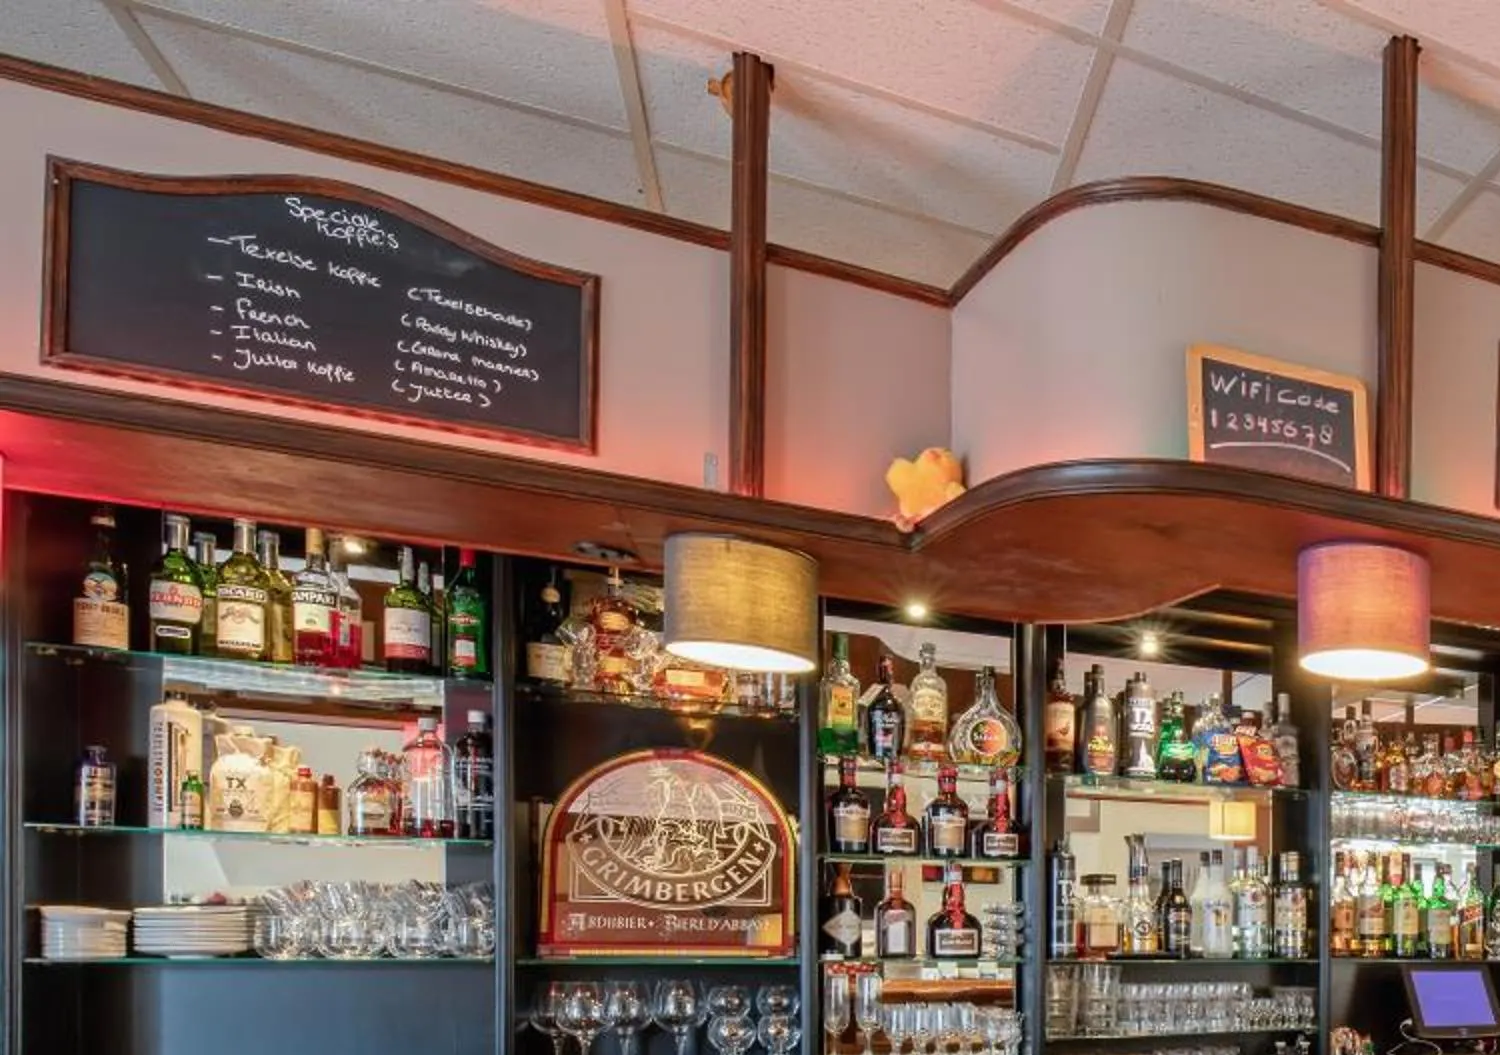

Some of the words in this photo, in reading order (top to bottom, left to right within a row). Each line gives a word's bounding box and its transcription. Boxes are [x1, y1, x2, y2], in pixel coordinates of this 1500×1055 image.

[285, 196, 382, 231] Speciale
[229, 234, 317, 271] Texelse
[235, 271, 301, 298] Irish
[236, 297, 311, 329] French
[230, 325, 317, 352] Italian
[1277, 389, 1340, 414] Code
[225, 776, 246, 789] TX
[582, 845, 763, 903] GRIMBERGEN
